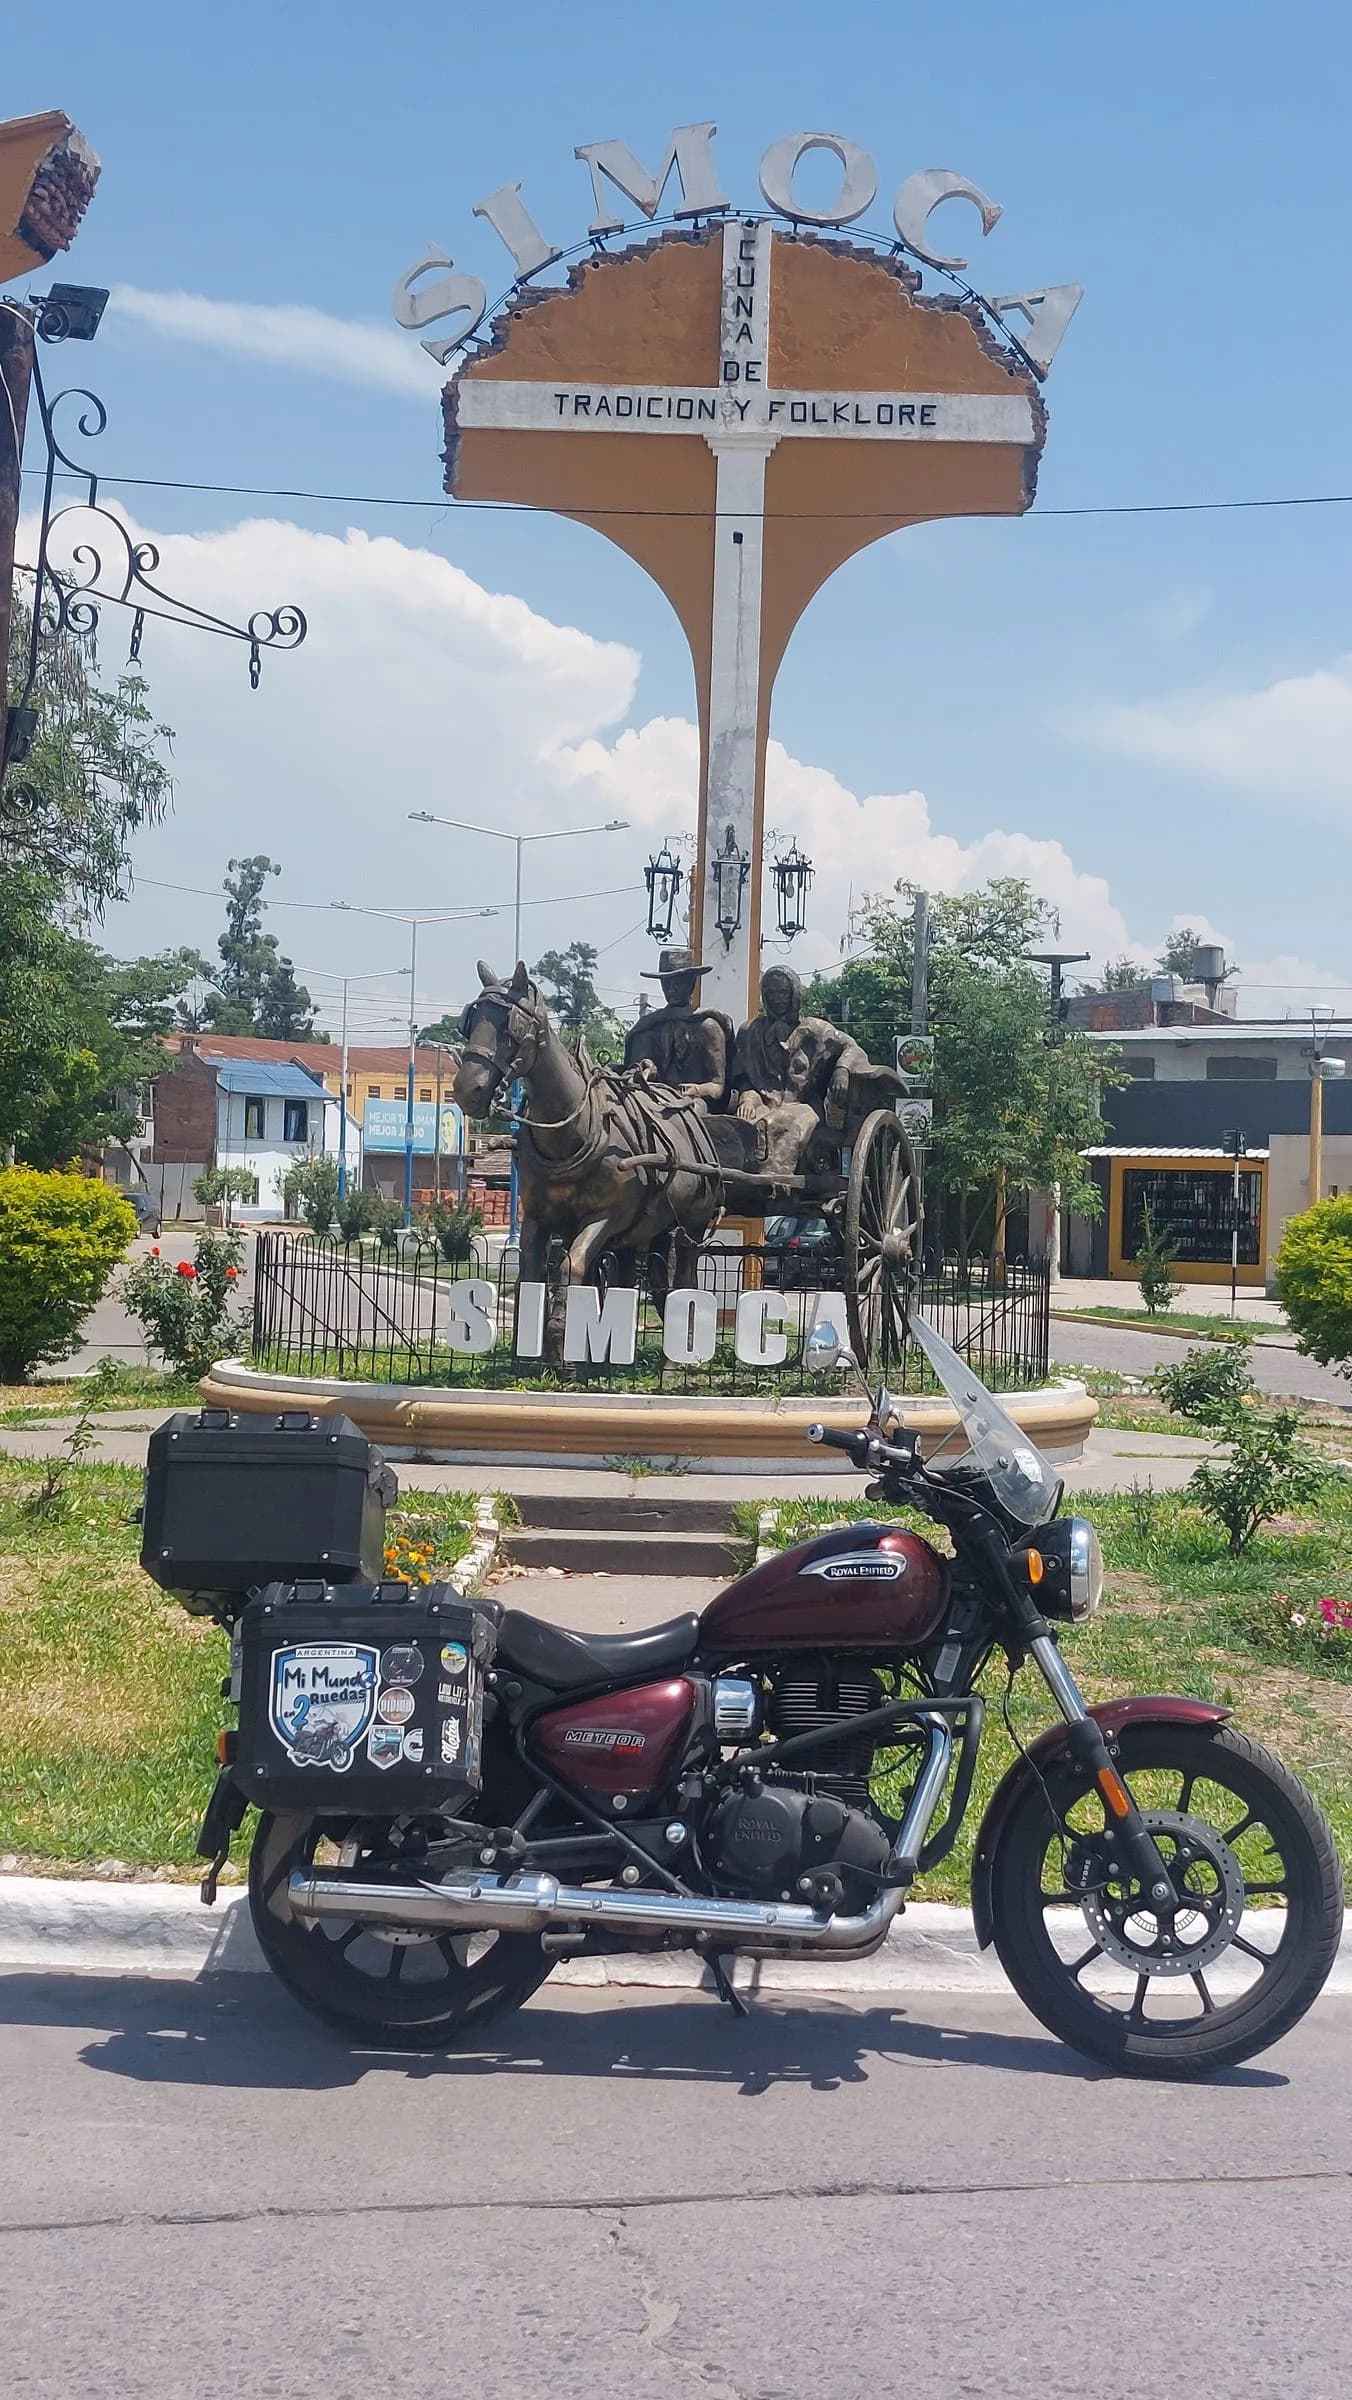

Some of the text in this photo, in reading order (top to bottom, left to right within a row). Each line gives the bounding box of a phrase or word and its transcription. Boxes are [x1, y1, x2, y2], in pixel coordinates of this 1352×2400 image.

[391, 121, 1084, 383] SIMOCA
[735, 239, 756, 345] CUNA
[723, 361, 762, 382] DE
[554, 393, 937, 426] TRADICION Y FOLKLORE
[369, 1111, 397, 1124] MEJOR
[369, 1124, 397, 1137] MEJOR
[447, 1279, 850, 1367] SIMOCA
[830, 1567, 859, 1577] ROYAL
[296, 1649, 355, 1657] ARGENTINA
[284, 1666, 306, 1689] Mi
[290, 1693, 311, 1728] 2
[310, 1687, 367, 1705] Ruedas
[565, 1730, 646, 1748] METEOR
